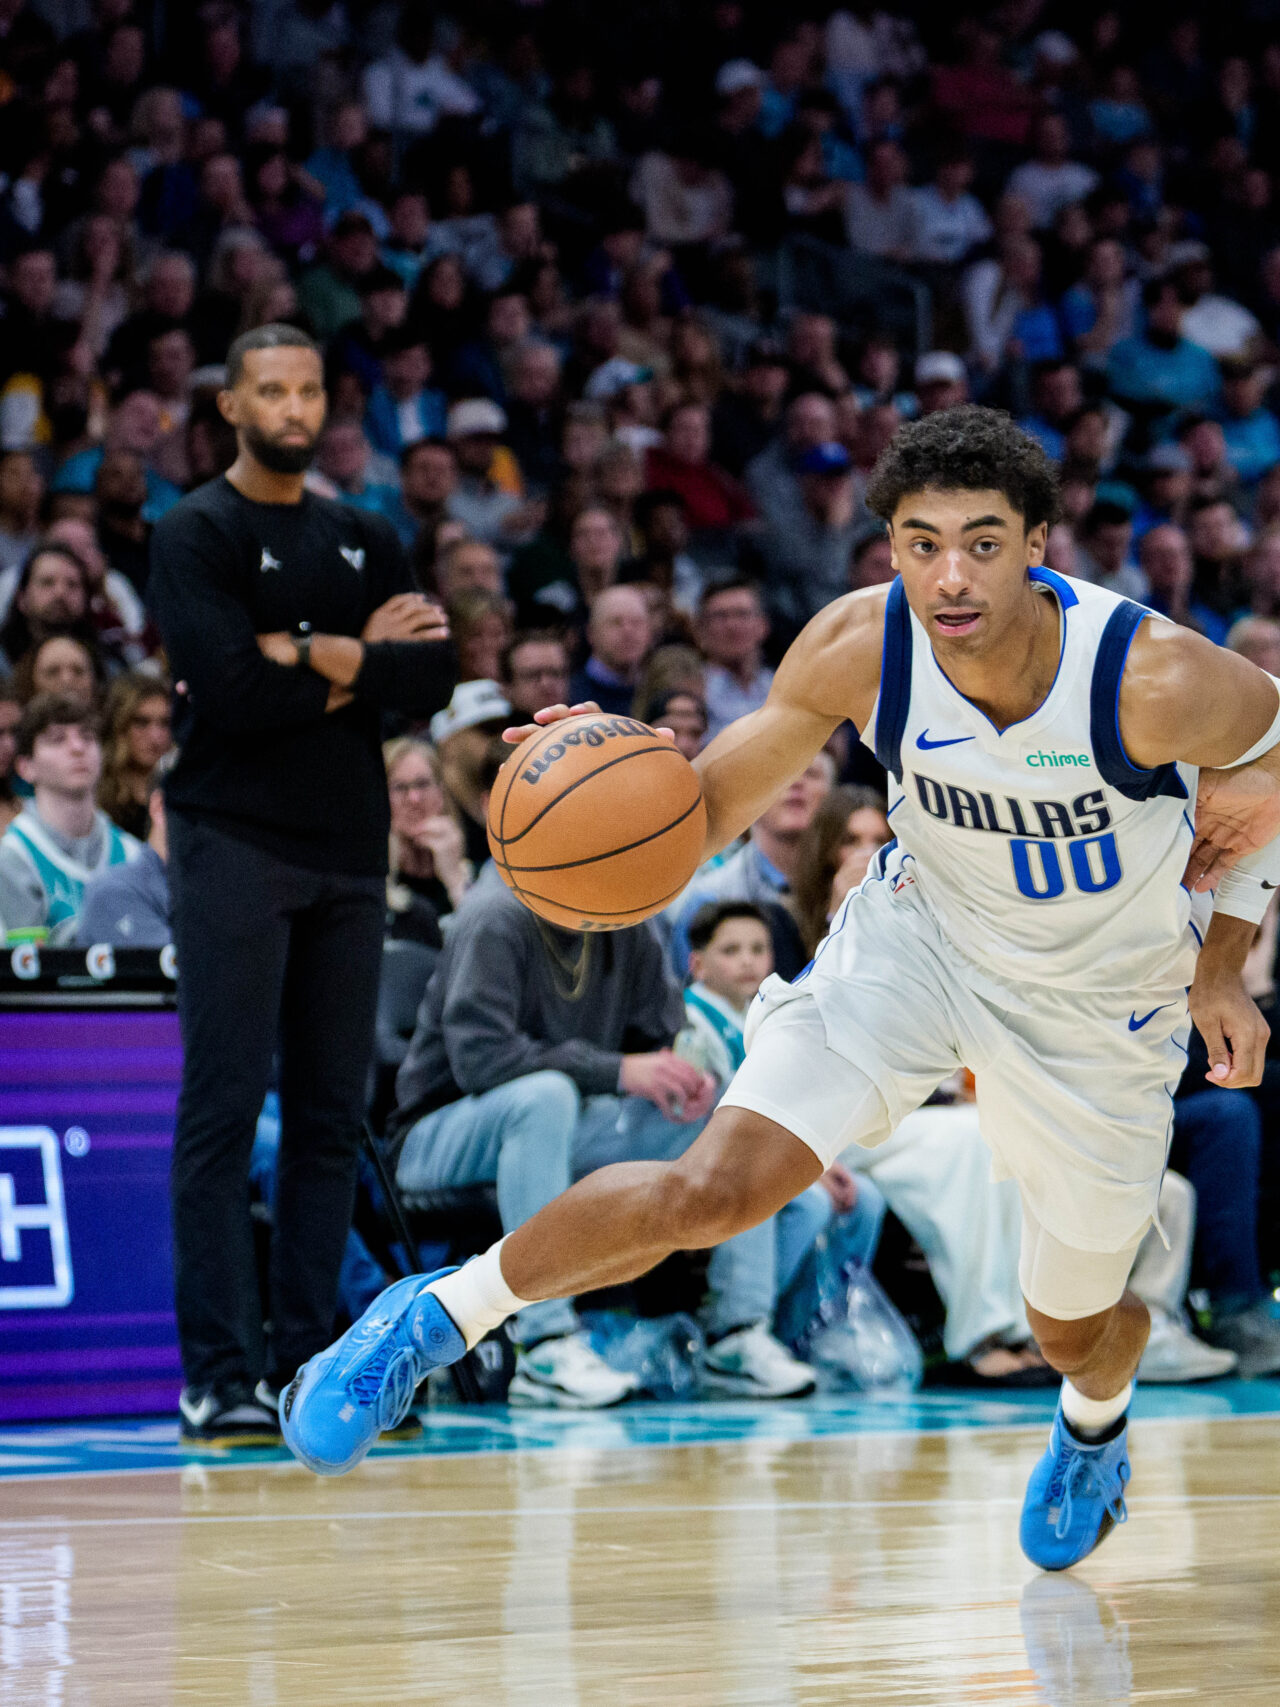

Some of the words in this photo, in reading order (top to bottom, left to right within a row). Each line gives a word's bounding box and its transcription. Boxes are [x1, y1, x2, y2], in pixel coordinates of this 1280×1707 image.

[520, 717, 659, 785] Wilson
[1026, 750, 1091, 768] chime
[912, 770, 1114, 838] DALLAS
[1009, 831, 1123, 899] 00
